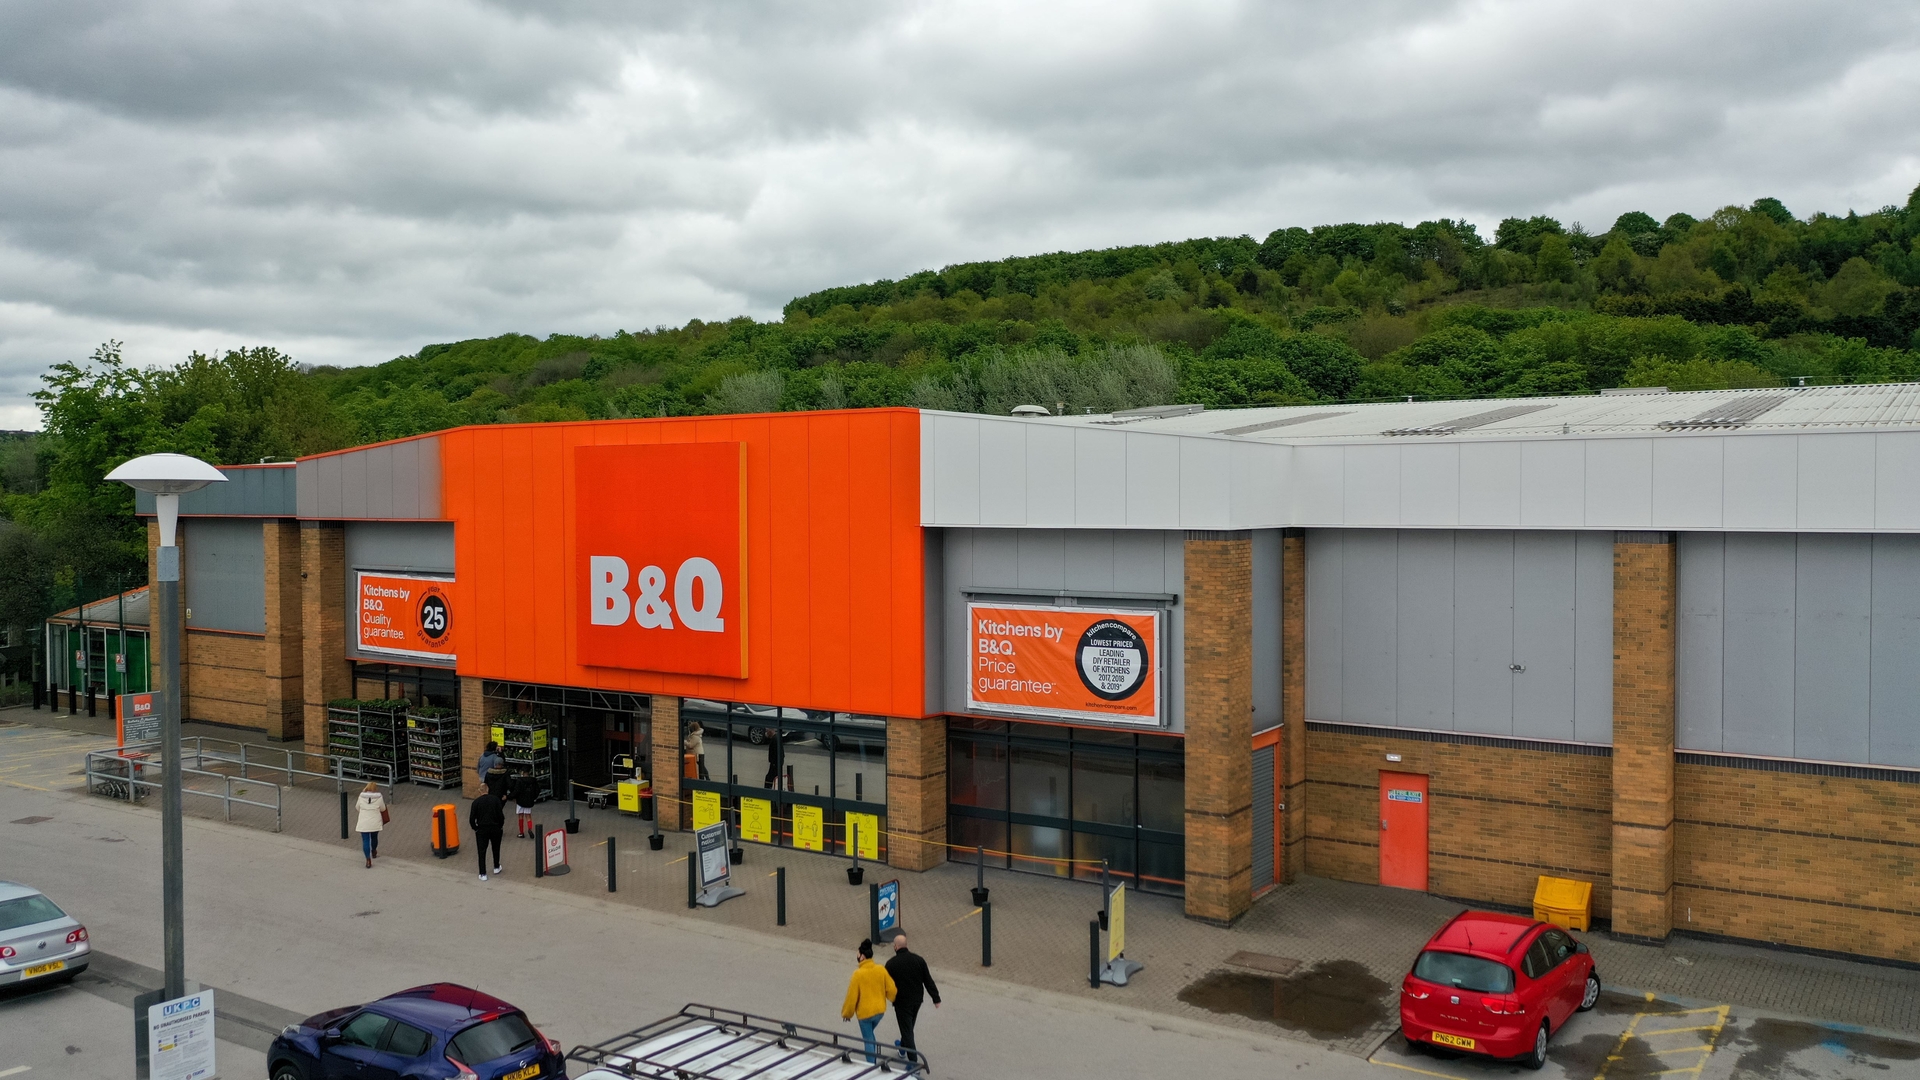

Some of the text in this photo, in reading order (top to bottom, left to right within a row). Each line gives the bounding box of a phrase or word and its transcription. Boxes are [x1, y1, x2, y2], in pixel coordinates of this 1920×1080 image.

[364, 584, 410, 602] Kitchens by
[590, 556, 724, 632] B&Q
[364, 599, 384, 611] B&Q.
[363, 612, 391, 628] Quality
[424, 606, 444, 630] 25
[364, 627, 405, 639] guarantee.
[978, 619, 1063, 643] Kitchens by
[978, 638, 1016, 656] B&Q.
[1099, 649, 1124, 658] LEADING
[979, 657, 1016, 673] Price
[1104, 658, 1130, 666] RETAILER
[1102, 666, 1130, 674] KITCHENS
[135, 703, 150, 711] B&Q
[701, 830, 722, 840] Customer
[701, 838, 715, 846] notice
[164, 998, 200, 1015] UKPC
[161, 1014, 192, 1028] UNAUTHORISED
[193, 1009, 210, 1019] PARKING
[1435, 1032, 1471, 1047] PN62 GWM
